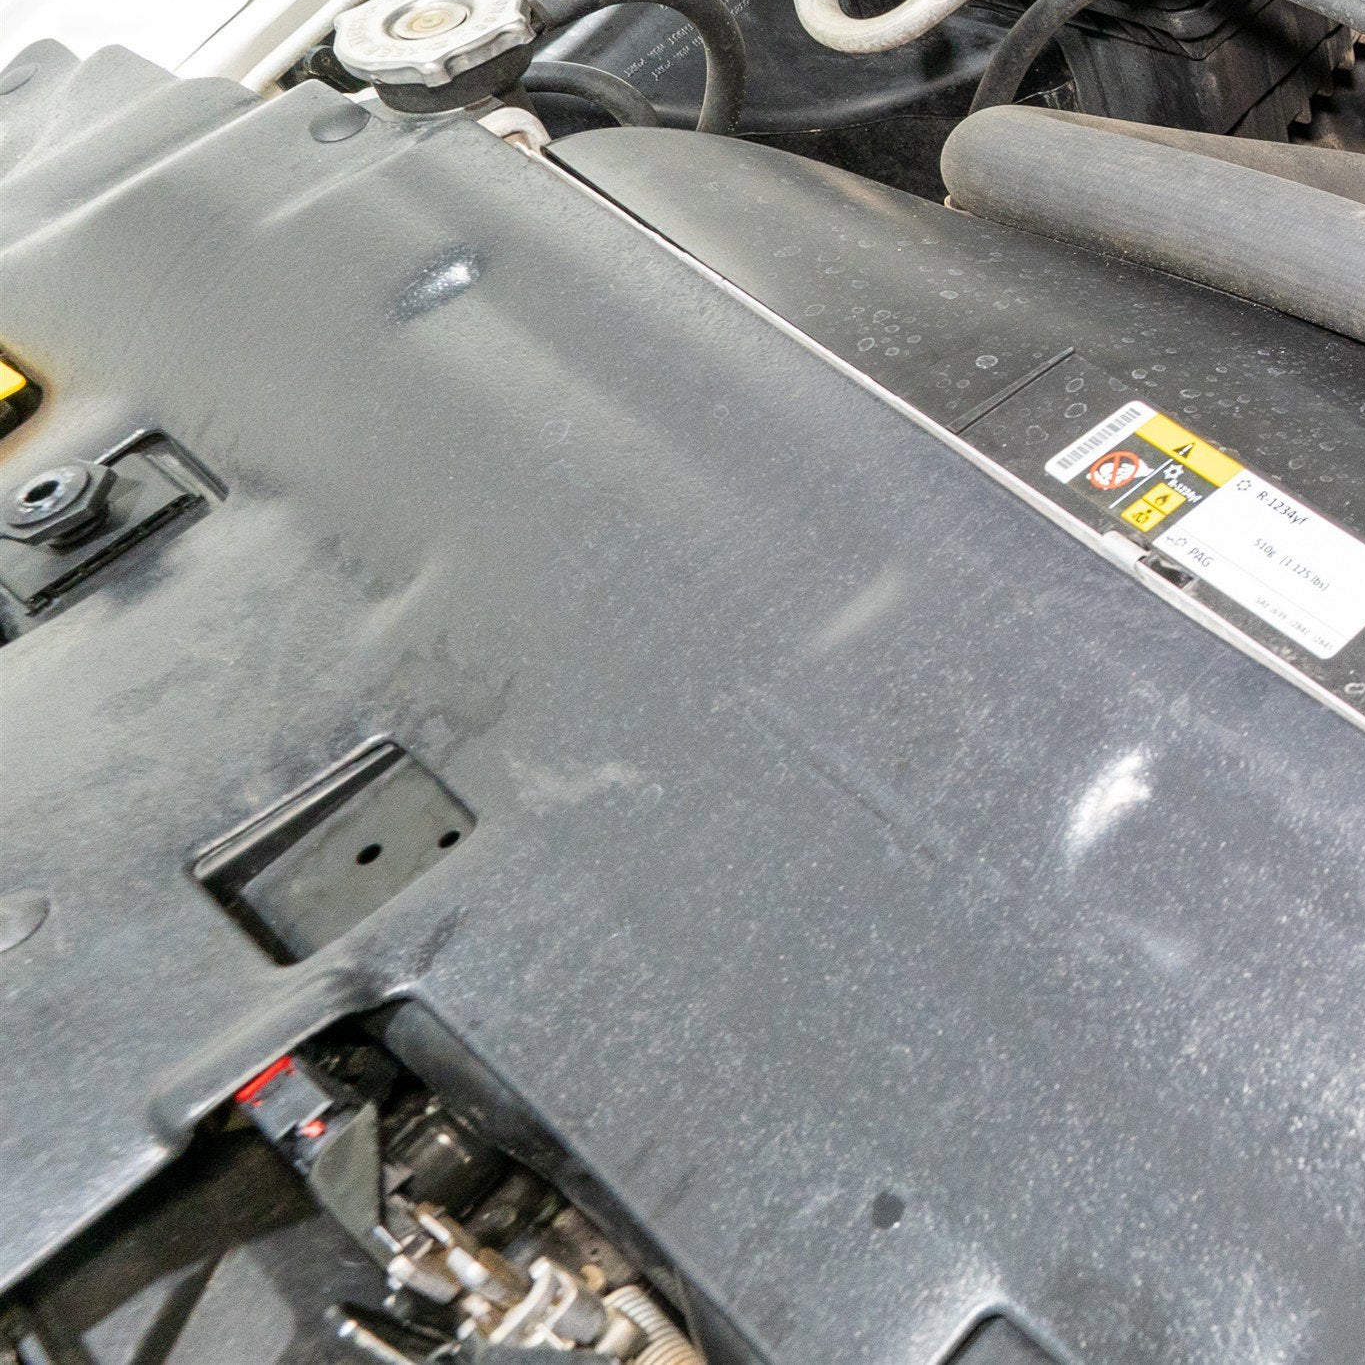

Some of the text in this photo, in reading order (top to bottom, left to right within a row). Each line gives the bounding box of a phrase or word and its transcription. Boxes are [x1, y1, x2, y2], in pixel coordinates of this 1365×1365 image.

[1254, 488, 1309, 528] R-1234yf
[1186, 545, 1215, 570] PAG
[1252, 537, 1278, 560] 510g
[1307, 573, 1331, 594] lbs)
